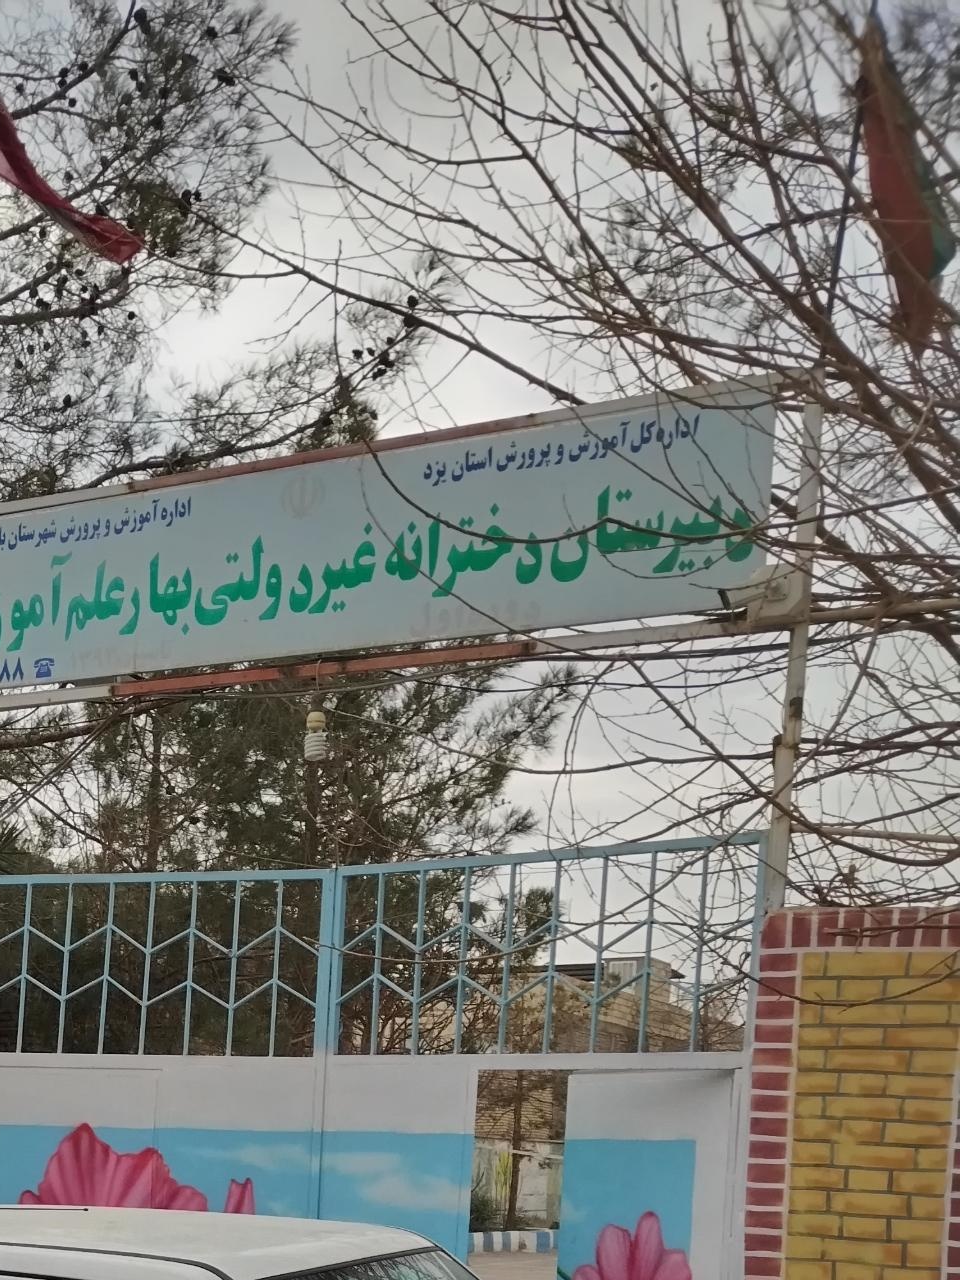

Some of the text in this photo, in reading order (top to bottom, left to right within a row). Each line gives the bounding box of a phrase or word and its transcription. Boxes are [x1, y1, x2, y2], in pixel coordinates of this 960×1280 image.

[423, 414, 700, 486] اداره کل آموزش و پرورش استان یزد
[7, 519, 57, 548] شهرستان
[59, 516, 101, 543] پرورش
[103, 519, 111, 537] و
[113, 498, 159, 534] آموزش
[160, 497, 192, 527] اداره
[550, 485, 756, 586] دبیرستان
[384, 503, 544, 598] دخترانه
[65, 560, 126, 641] علم
[119, 552, 194, 637] بهار
